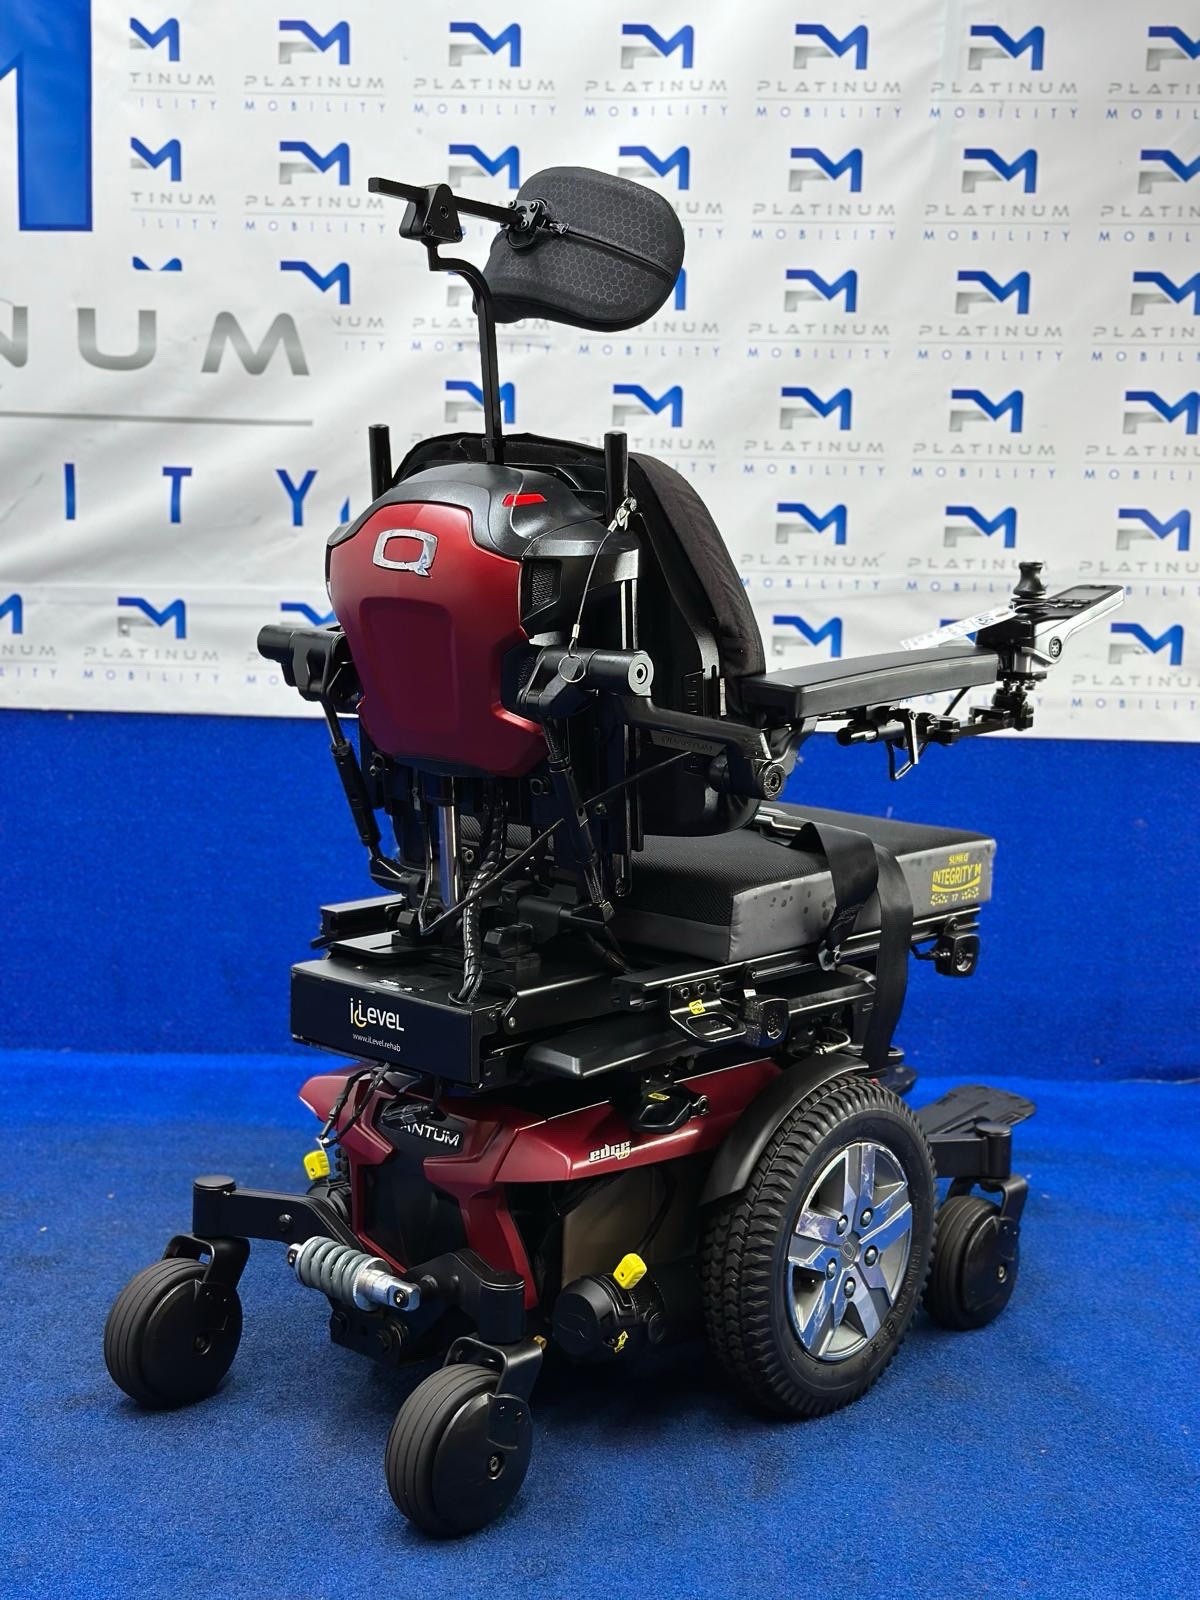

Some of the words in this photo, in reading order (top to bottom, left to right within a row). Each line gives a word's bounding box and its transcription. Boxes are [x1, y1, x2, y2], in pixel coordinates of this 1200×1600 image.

[244, 76, 384, 89] PLATINUM
[413, 78, 555, 91] PLATINUM
[585, 80, 727, 93] PLATINUM
[757, 81, 902, 94] PLATINUM
[931, 82, 1077, 94] PLATINUM
[1109, 83, 1200, 95] PLATI
[244, 100, 385, 112] MOBILITY
[413, 103, 557, 115] MOBILITY
[584, 105, 728, 117] MOBILITY
[756, 107, 903, 119] MOBILITY
[929, 108, 1078, 120] MOBILITY
[244, 195, 384, 208] PLATINUM
[751, 203, 895, 216] PLATINUM
[924, 204, 1070, 217] PLATINUM
[244, 221, 385, 233] MOBILITY
[751, 229, 896, 241] MOBILITY
[923, 231, 1070, 242] MOBILITY
[748, 323, 889, 336] PLATINUM
[919, 325, 1062, 337] PLATINUM
[578, 345, 720, 357] MOBILITY
[747, 347, 889, 360] MOBILITY
[917, 349, 1062, 361] MOBILITY
[744, 440, 884, 453] PLATINUM
[912, 442, 1055, 455] PLATINUM
[743, 463, 884, 476] MOBILITY
[911, 467, 1056, 479] MOBILITY
[740, 554, 881, 567] PLATINUM
[84, 646, 219, 661] PLATINUM
[82, 669, 219, 683] MOBILITY
[1071, 674, 1200, 688] PLATINU
[932, 865, 973, 885] INTEGRITY
